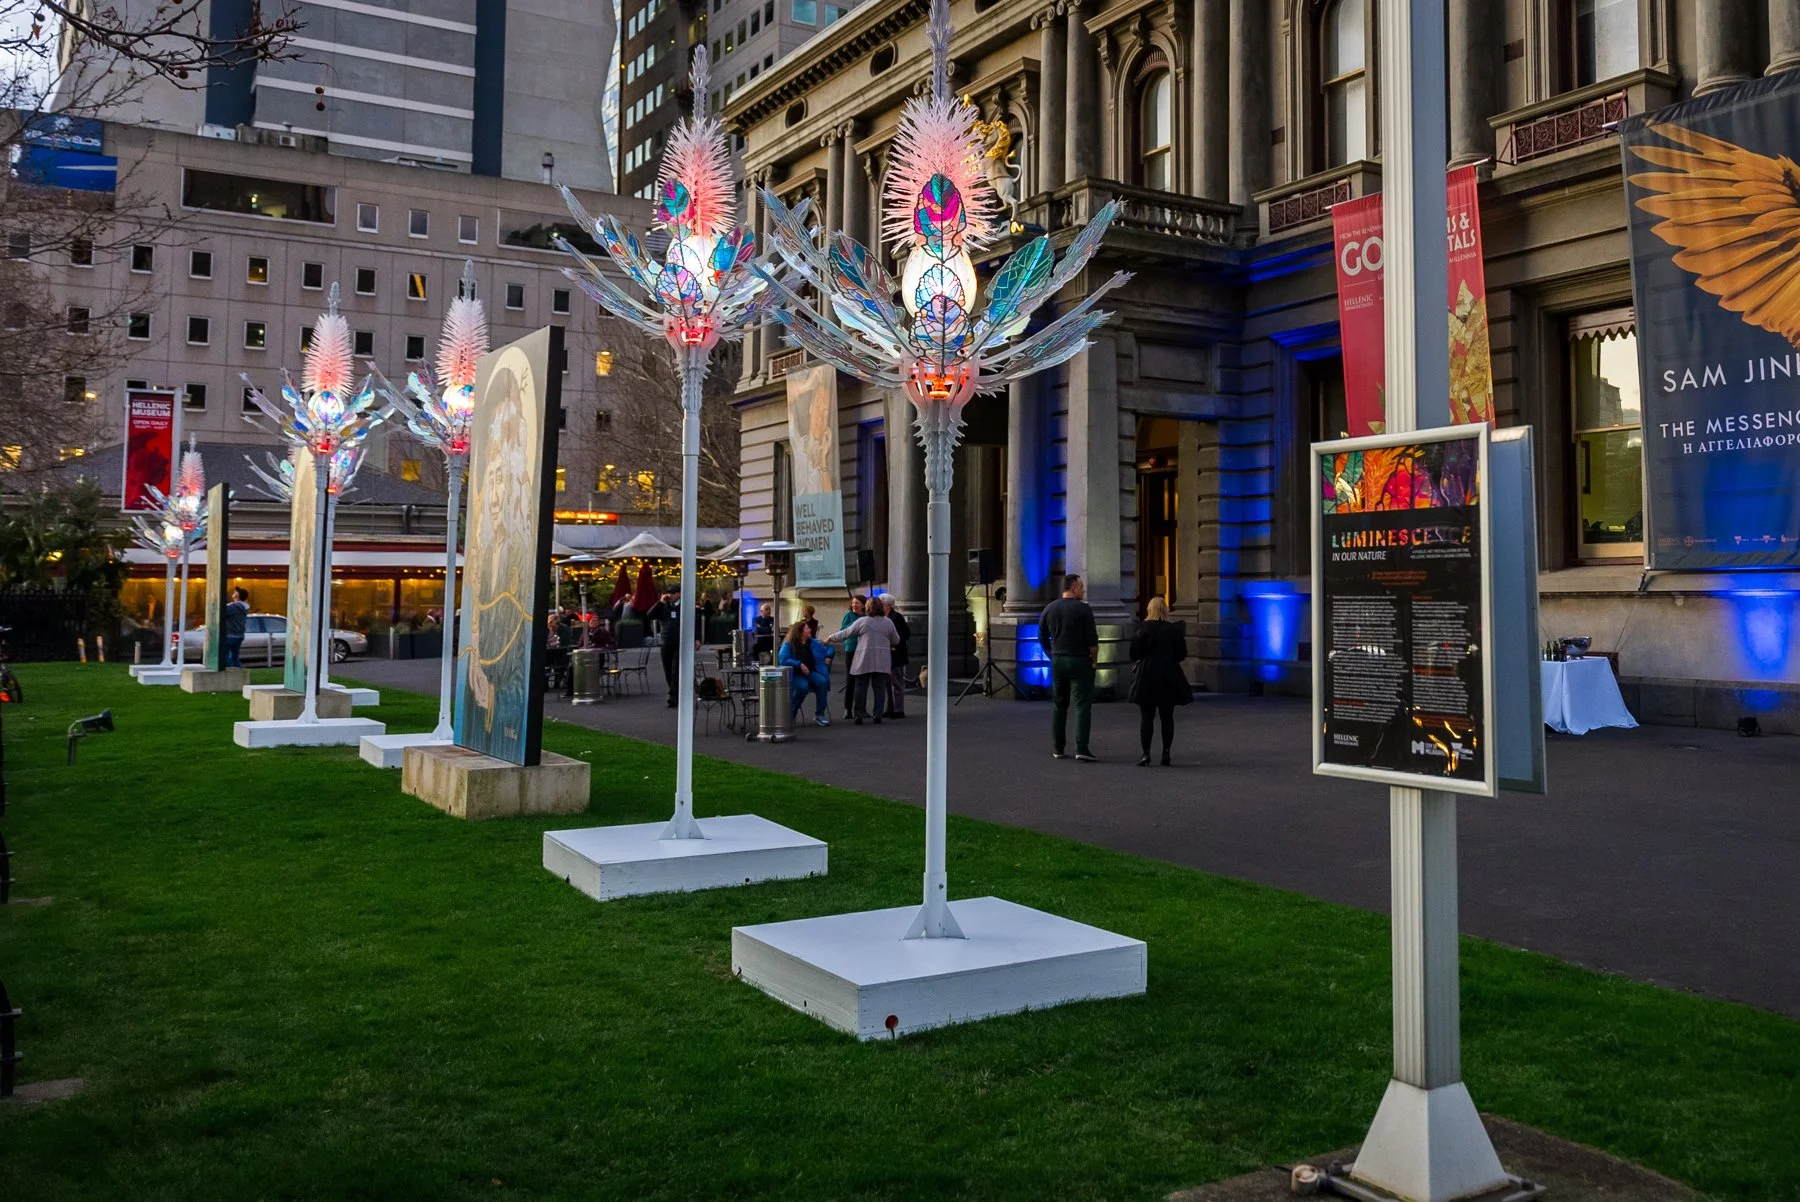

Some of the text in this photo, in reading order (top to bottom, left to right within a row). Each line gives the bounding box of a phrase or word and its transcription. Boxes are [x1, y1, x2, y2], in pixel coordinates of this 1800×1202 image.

[1344, 294, 1374, 307] HELLENIC
[1663, 363, 1727, 392] SAM
[1660, 409, 1800, 438] THE MESSEN
[795, 504, 816, 518] WELL
[796, 519, 834, 535] BEHAVED
[797, 536, 830, 551] WOMEN
[1332, 551, 1386, 561] IN OUR NATURE
[1333, 733, 1359, 742] HELLENIC
